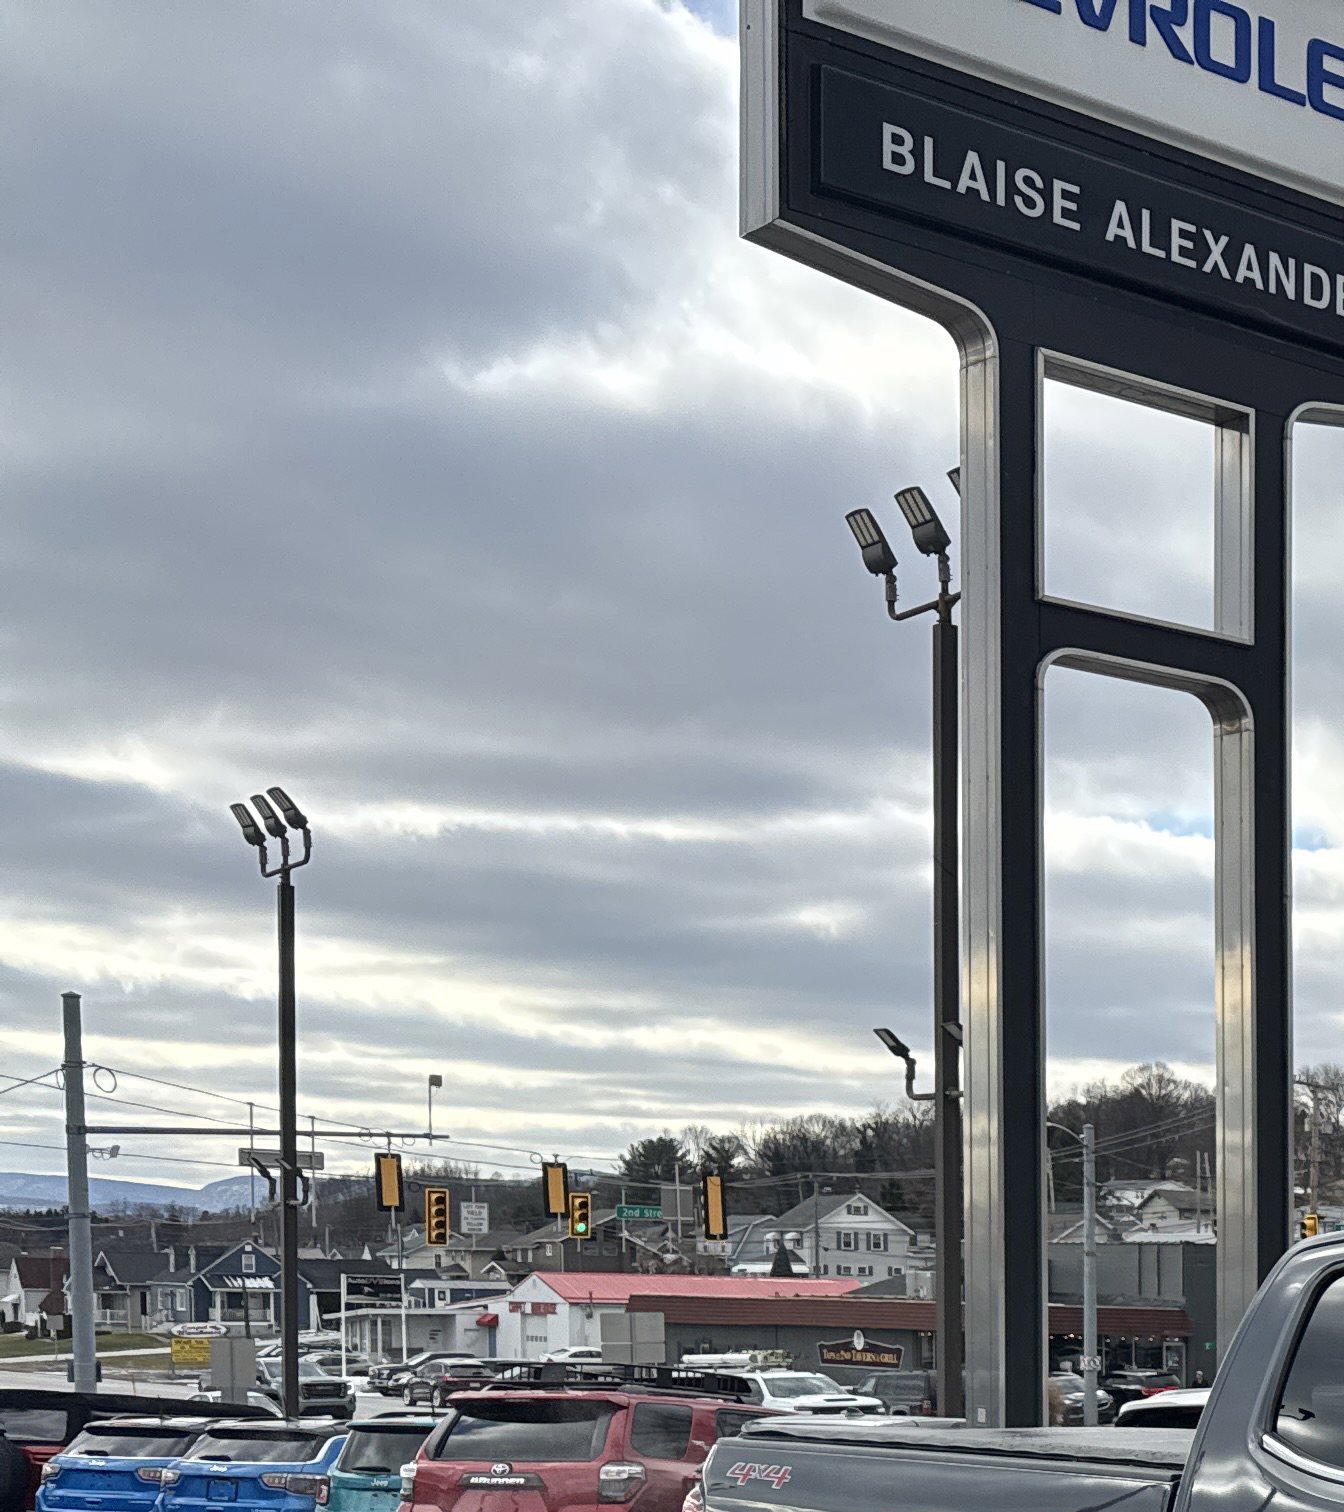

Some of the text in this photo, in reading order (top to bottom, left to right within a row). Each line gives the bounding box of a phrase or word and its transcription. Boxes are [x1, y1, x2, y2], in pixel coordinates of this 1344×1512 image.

[882, 121, 1081, 232] BLAISE
[622, 1207, 662, 1218] 2nd Stre
